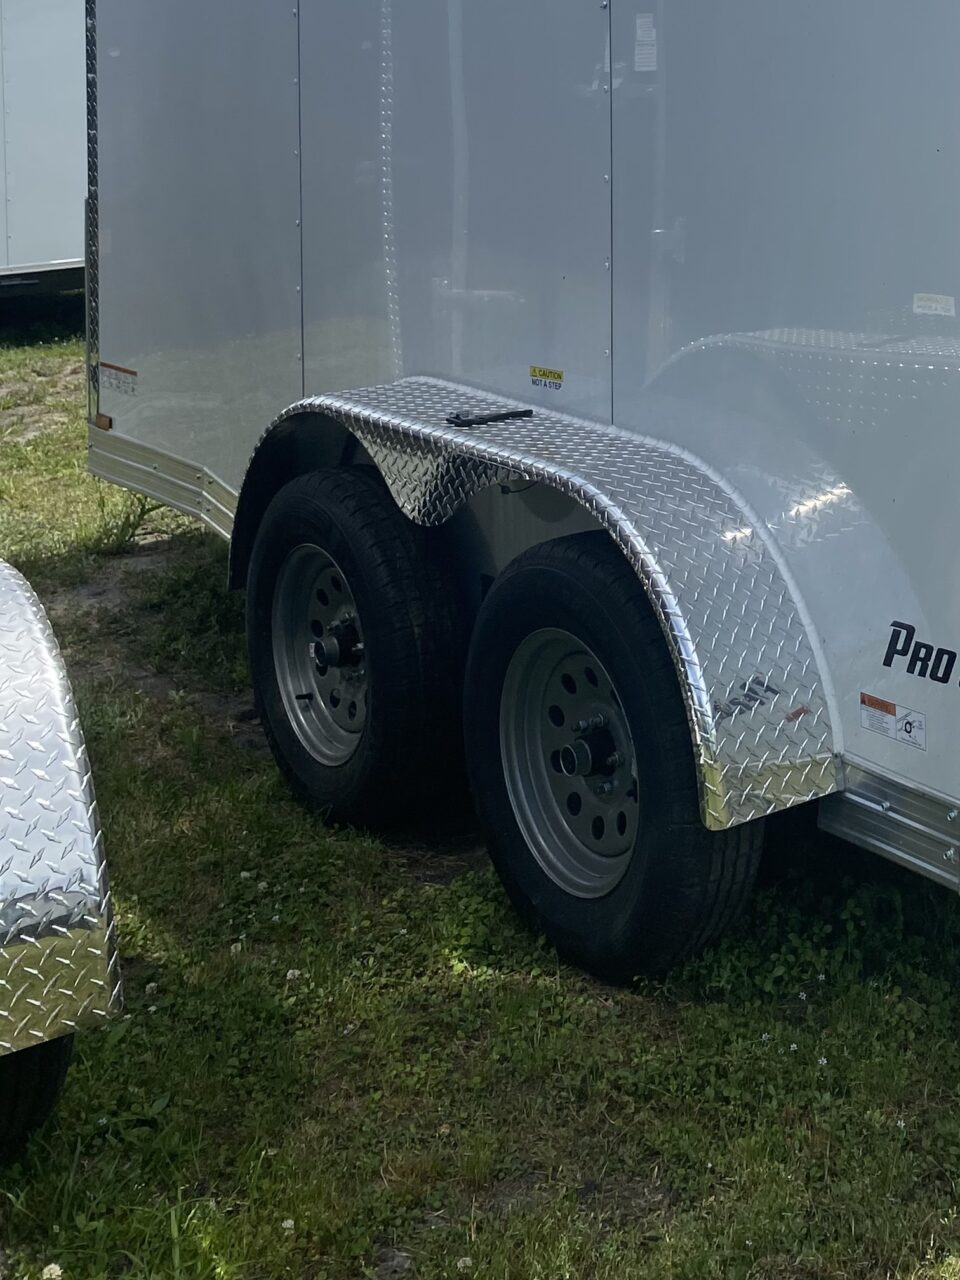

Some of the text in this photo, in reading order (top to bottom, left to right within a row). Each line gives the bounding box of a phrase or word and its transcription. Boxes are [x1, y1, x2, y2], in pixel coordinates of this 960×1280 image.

[538, 369, 562, 380] CAUTION
[531, 378, 542, 387] NOT
[548, 381, 562, 390] STEP
